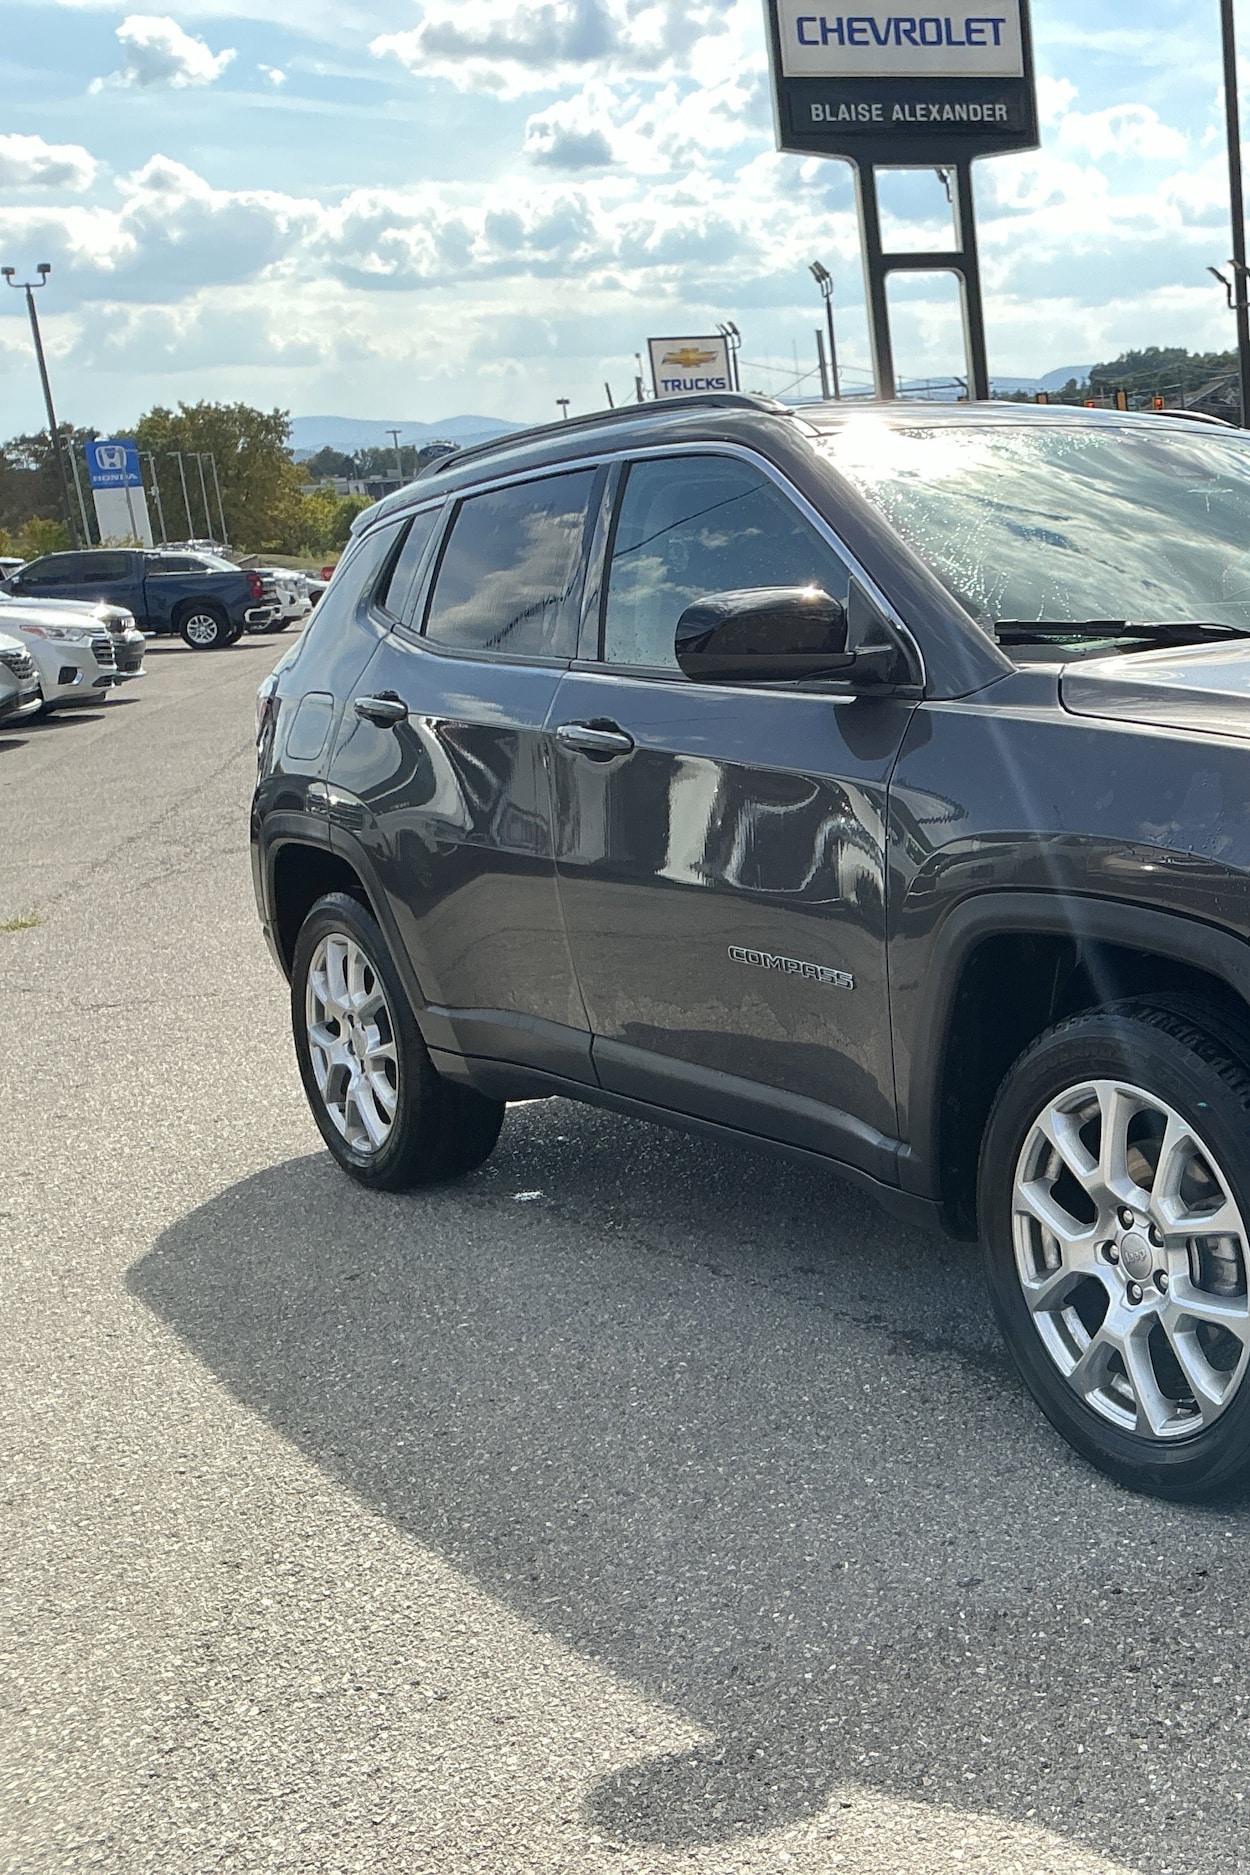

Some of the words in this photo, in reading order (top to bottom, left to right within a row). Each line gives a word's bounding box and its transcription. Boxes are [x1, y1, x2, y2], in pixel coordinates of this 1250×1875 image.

[796, 16, 1006, 46] CHEVROLET
[810, 103, 884, 122] BLAISE
[891, 103, 1008, 122] ALEXANDER
[661, 377, 726, 391] TRUCKS
[727, 945, 854, 991] COMPASS
[1124, 1249, 1147, 1263] Jeep
